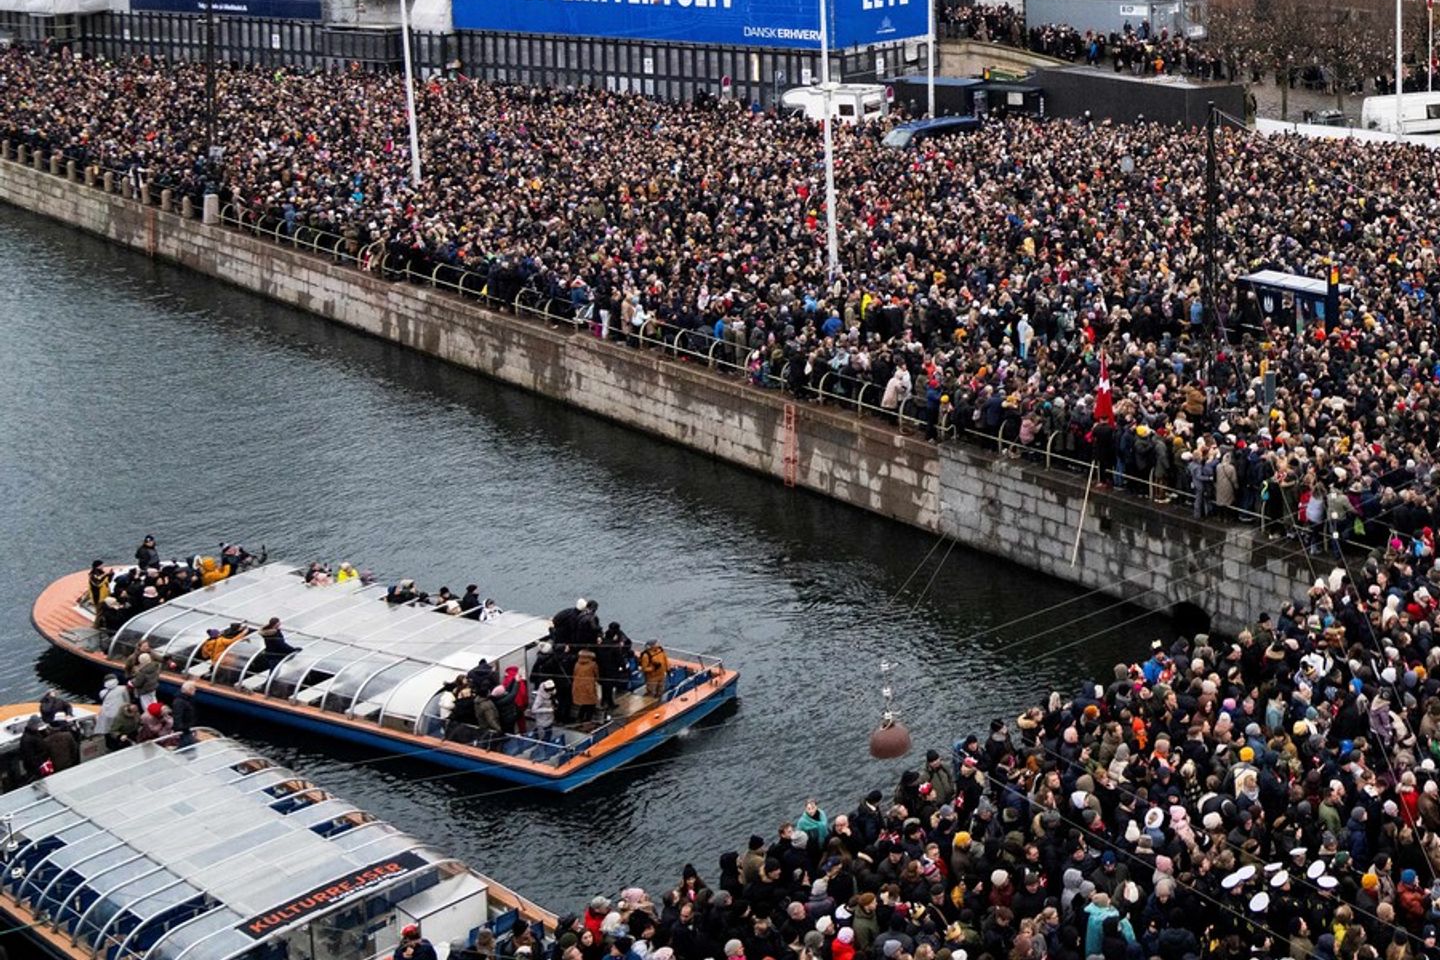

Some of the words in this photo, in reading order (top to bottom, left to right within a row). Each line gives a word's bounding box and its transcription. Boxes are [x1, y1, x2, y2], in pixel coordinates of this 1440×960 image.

[743, 26, 777, 38] DANSK
[777, 28, 821, 41] ERHVERV
[249, 861, 403, 934] KULTURREJSER
